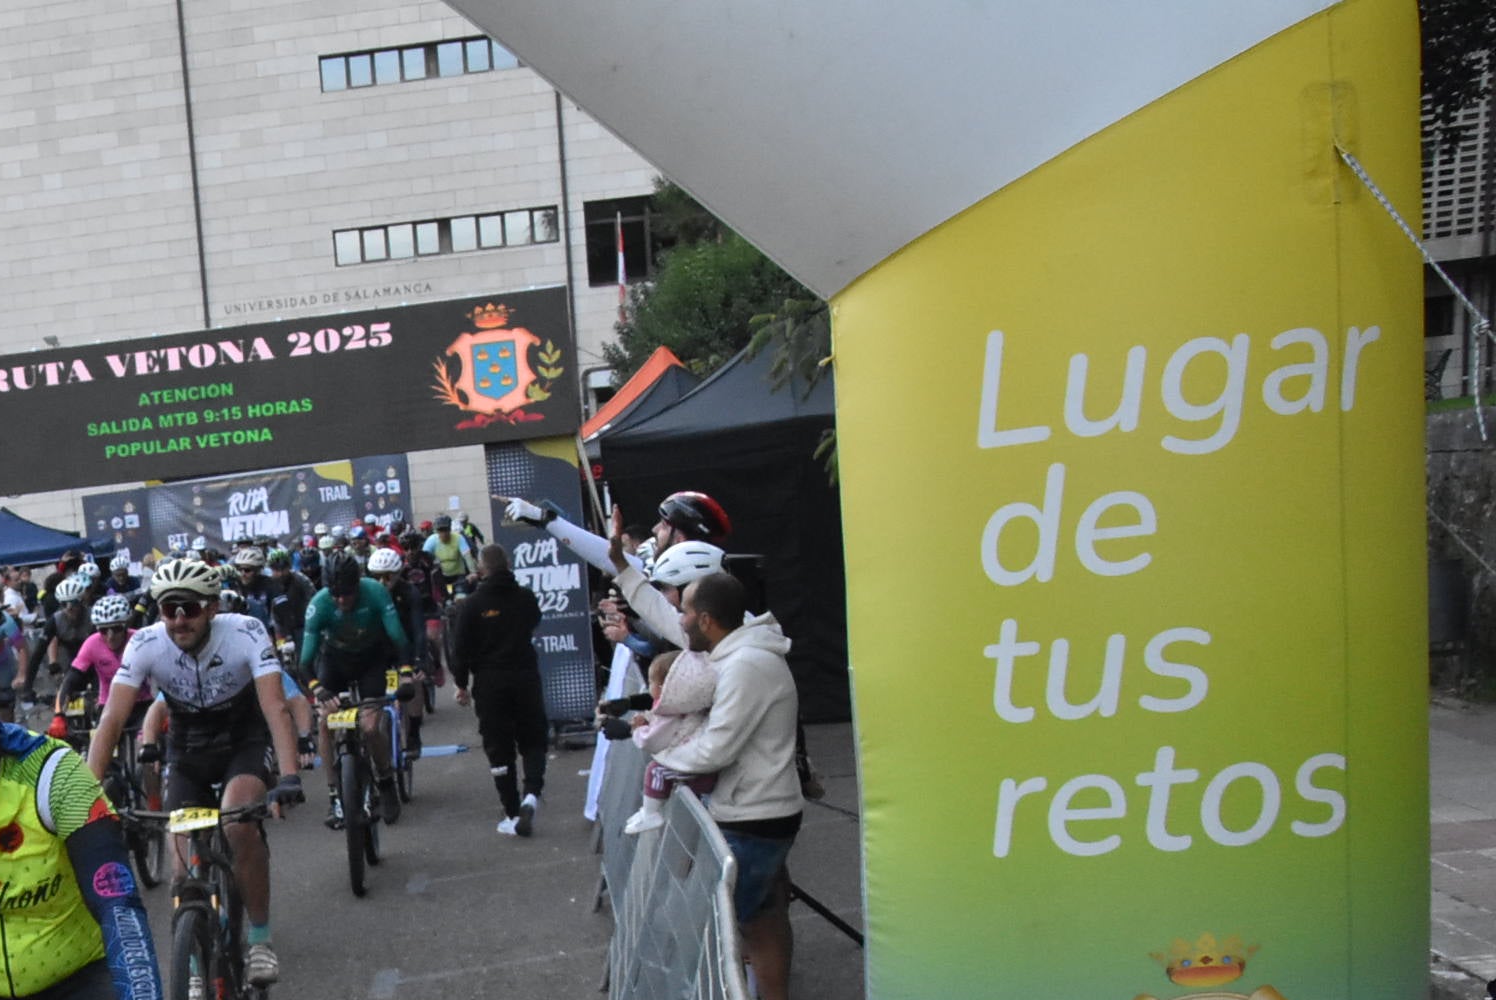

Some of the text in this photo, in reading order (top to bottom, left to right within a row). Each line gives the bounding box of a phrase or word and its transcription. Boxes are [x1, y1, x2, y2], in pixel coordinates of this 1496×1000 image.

[224, 282, 433, 315] UNIVERSIDAD DE SALAMANCA
[105, 336, 275, 378] VETONA
[286, 321, 393, 358] 2025
[137, 382, 234, 407] ATENCION
[977, 325, 1381, 456] Lugar
[87, 398, 314, 437] SALIDA MTB 9:15 HORAS
[105, 428, 273, 459] POPULAR VETONA
[228, 486, 270, 516] RUTA
[317, 483, 352, 503] TRAIL
[220, 509, 291, 542] VETONA
[979, 461, 1158, 587] de
[513, 537, 559, 568] RUTA
[513, 563, 582, 593] ETONA
[982, 617, 1212, 724] tus
[991, 745, 1348, 858] retos
